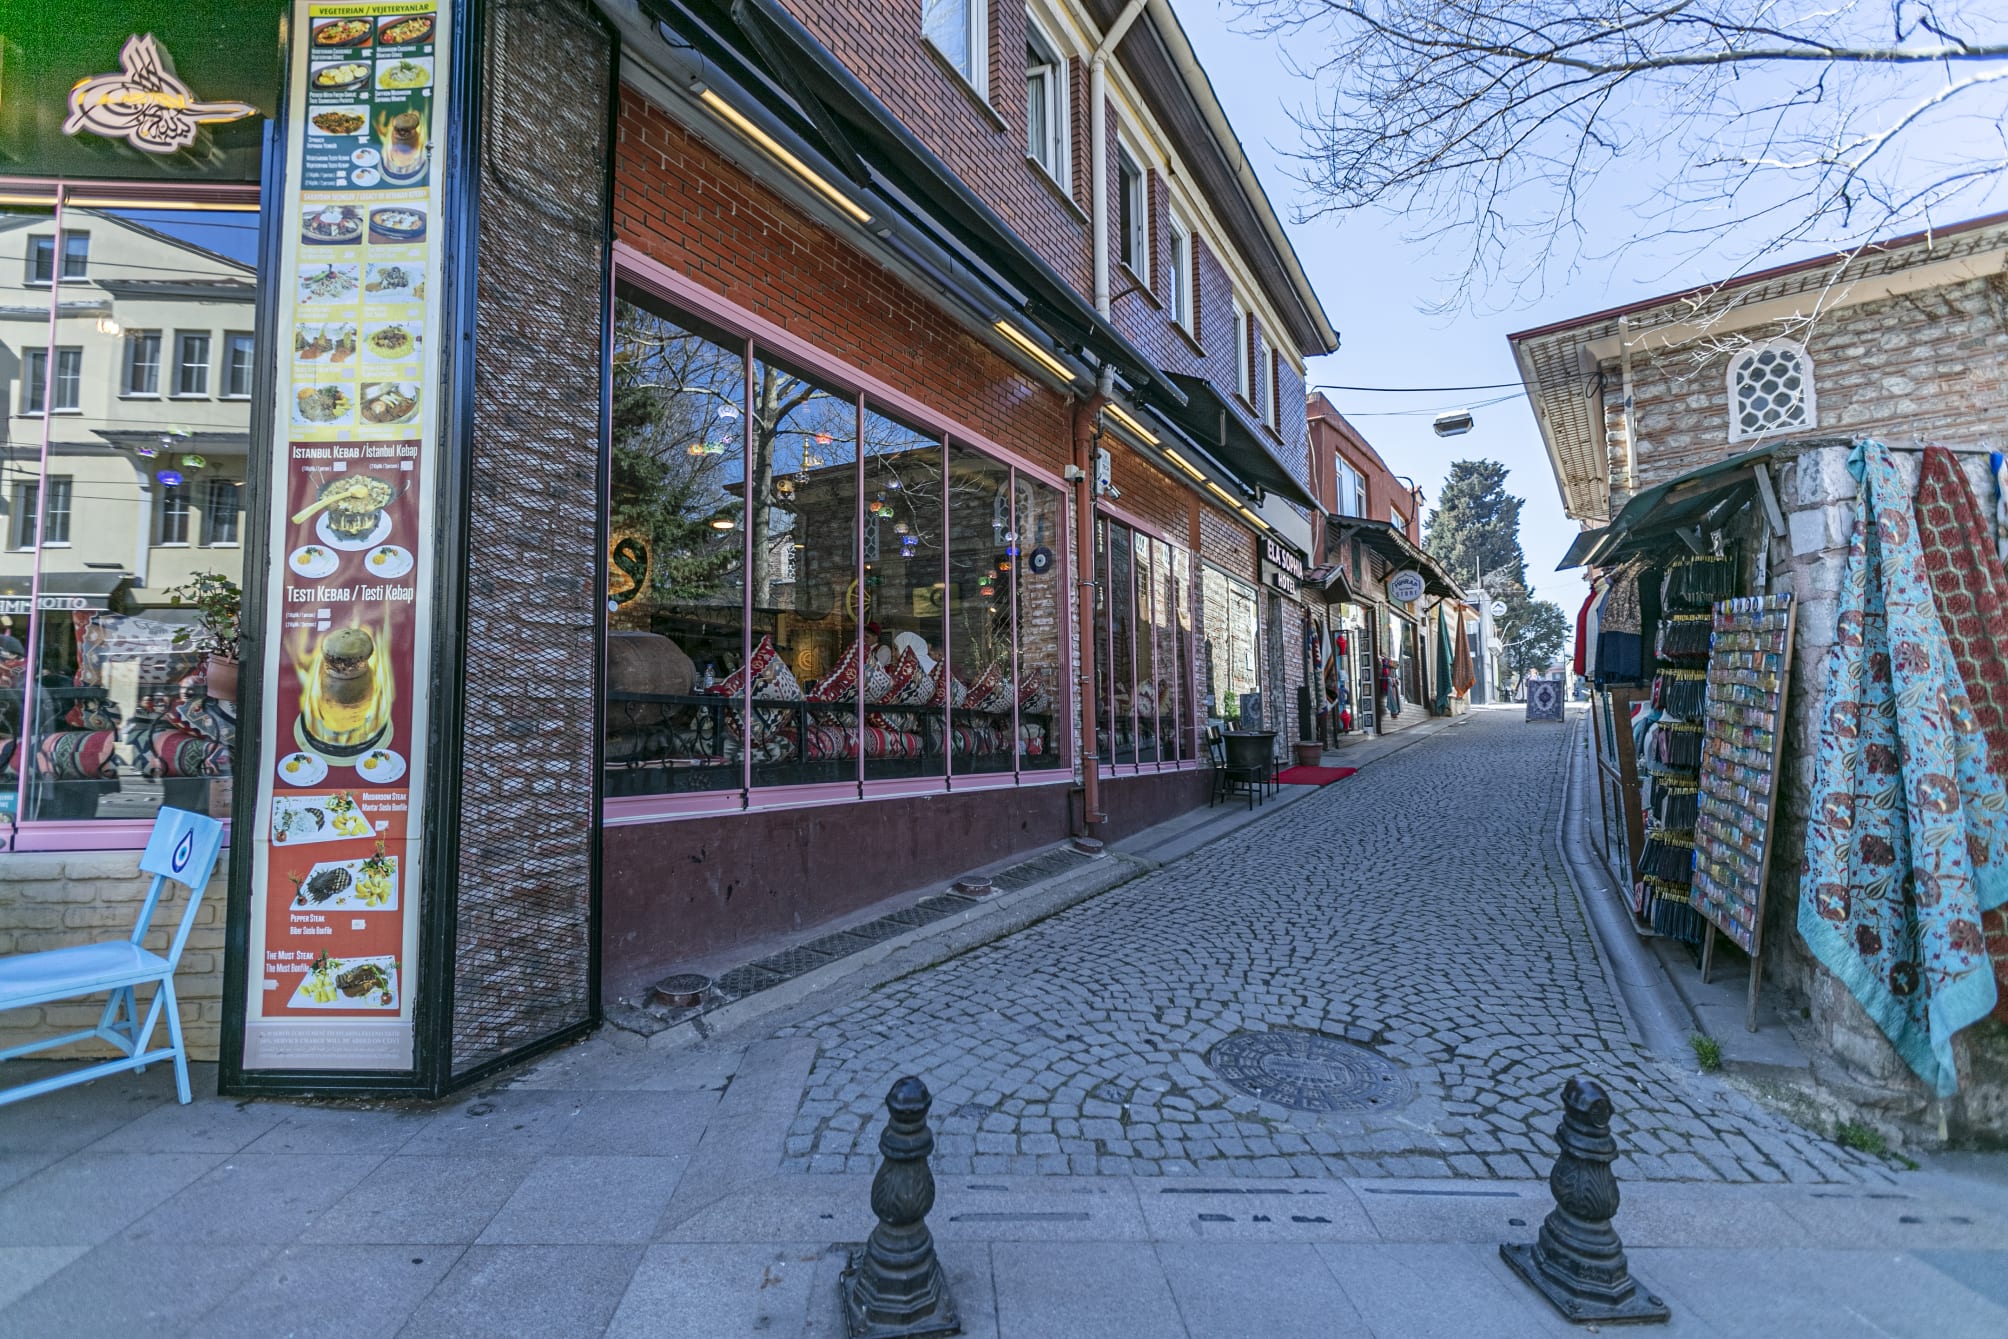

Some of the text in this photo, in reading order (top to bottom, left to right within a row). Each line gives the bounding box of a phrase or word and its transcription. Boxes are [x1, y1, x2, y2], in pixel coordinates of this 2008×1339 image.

[319, 7, 364, 15] VEGETERIAN
[333, 445, 360, 459] KEBAB
[396, 444, 418, 460] Kebap
[1267, 538, 1281, 566] ELA
[1278, 571, 1297, 595] HOTEL
[317, 585, 350, 602] KEBAB
[361, 584, 384, 601] Testi
[385, 584, 414, 604] Kebap
[310, 914, 325, 922] STEAK
[266, 950, 277, 960] THE
[296, 950, 314, 960] STEAK
